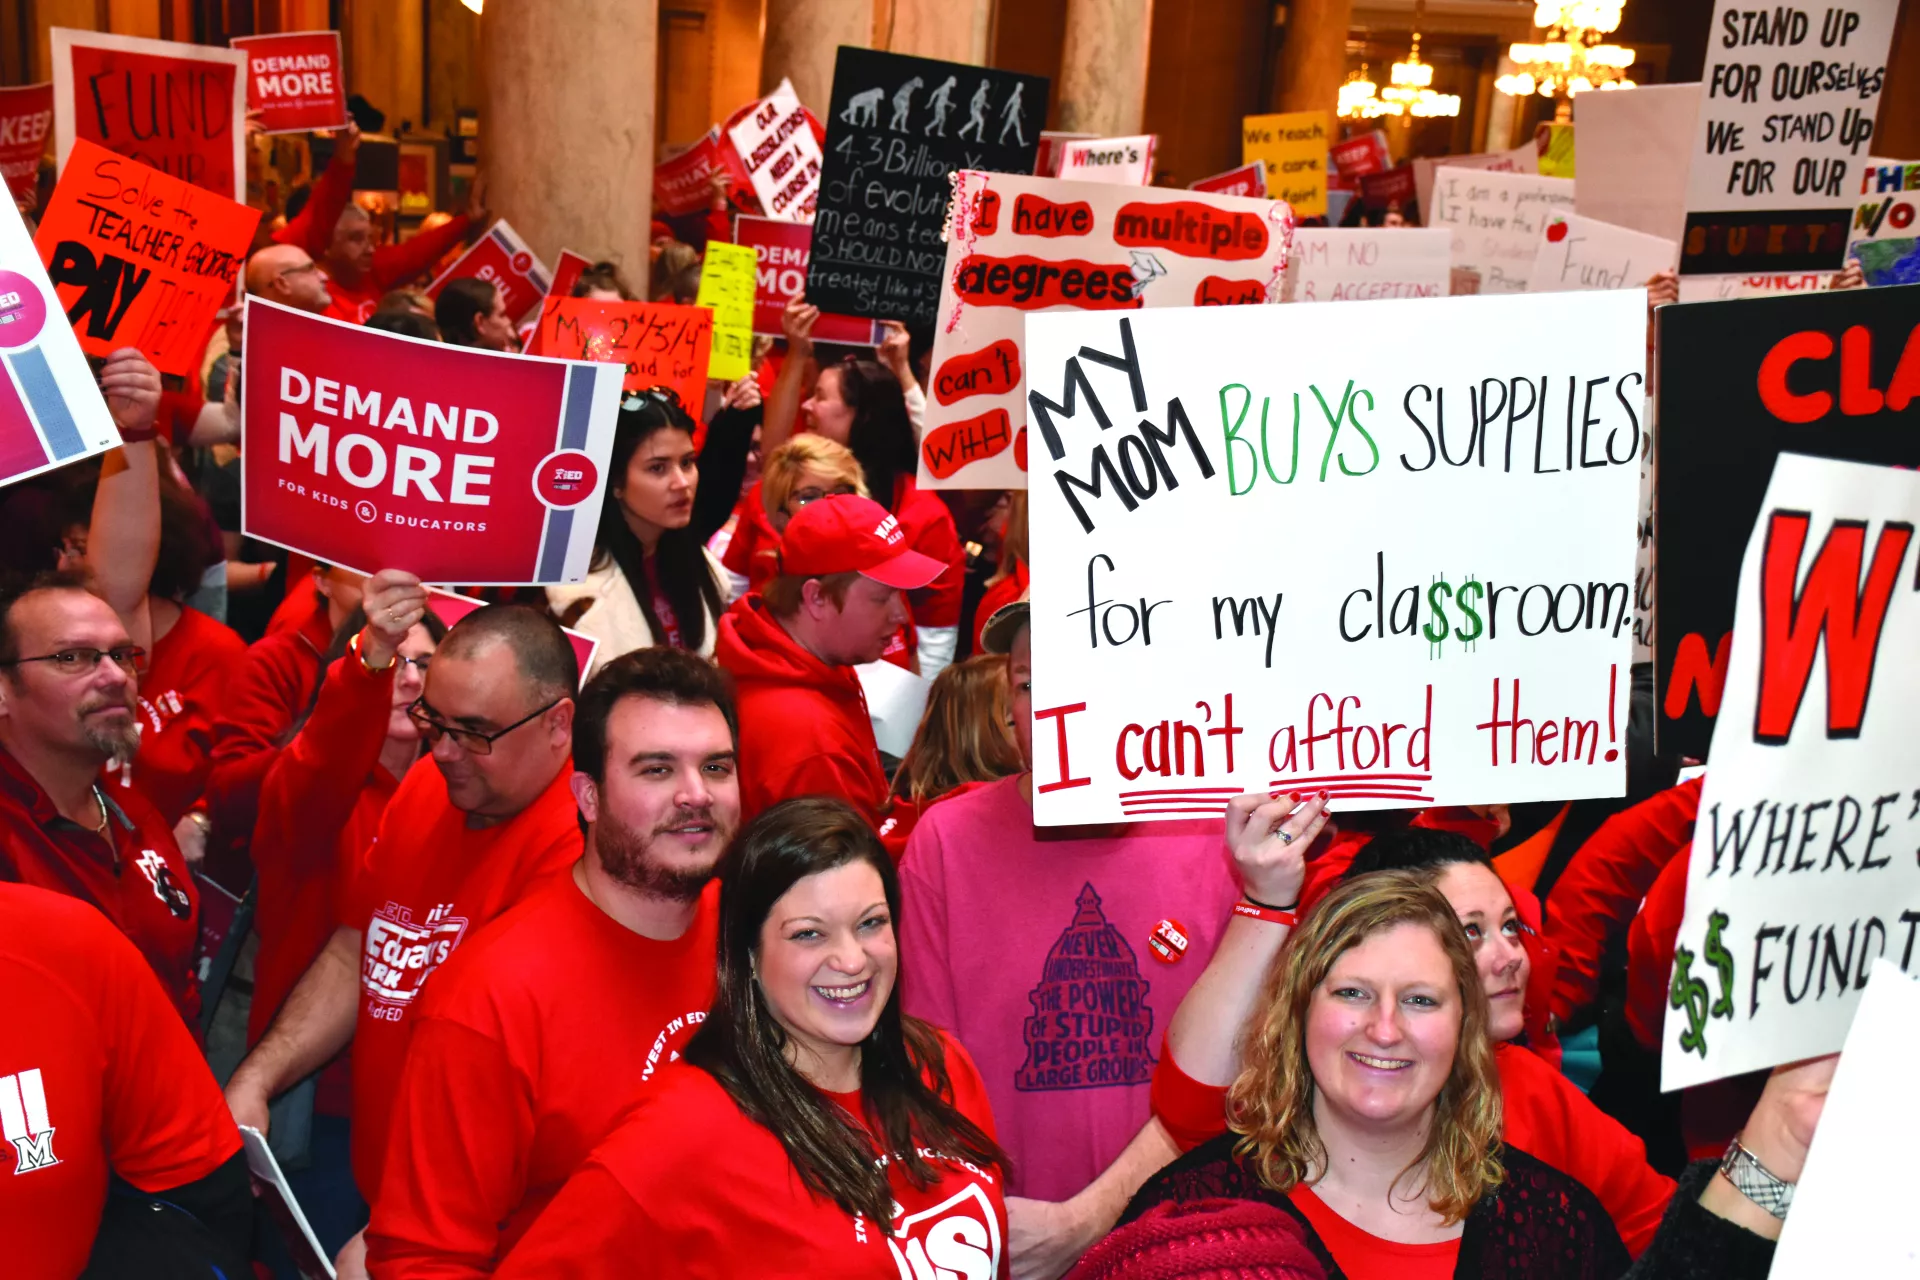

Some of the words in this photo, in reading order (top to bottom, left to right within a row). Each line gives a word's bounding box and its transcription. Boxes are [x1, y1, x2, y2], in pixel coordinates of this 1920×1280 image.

[1722, 7, 1808, 48] STAND
[1820, 8, 1860, 48] UP
[251, 54, 331, 74] DEMAND
[256, 72, 334, 98] MORE
[1709, 63, 1761, 103] FOR
[1771, 61, 1885, 101] OURSELVES
[89, 69, 230, 141] FUND
[756, 102, 778, 130] OUR
[743, 107, 806, 175] LEGISLATORS
[1706, 120, 1745, 155] WE
[1762, 112, 1835, 143] STAND
[1839, 108, 1874, 155] UP
[770, 151, 794, 182] NEED
[793, 144, 803, 158] A
[835, 134, 884, 168] 4.3
[884, 138, 957, 177] Billion
[1072, 146, 1138, 167] Where's
[86, 160, 164, 217] Solve
[772, 170, 808, 214] COURSE
[827, 167, 864, 204] of
[865, 181, 949, 216] evoluti
[1727, 158, 1775, 196] FOR
[1793, 158, 1847, 197] OUR
[77, 199, 184, 268] TEACHER
[815, 208, 900, 241] means
[974, 195, 996, 230] I
[1015, 197, 1089, 232] have
[1116, 209, 1263, 255] multiple
[1468, 206, 1506, 229] have
[817, 235, 901, 265] SHOULD
[904, 250, 946, 273] NOT
[1293, 241, 1329, 266] AM
[1347, 242, 1380, 266] NO
[1560, 237, 1631, 290] Fund
[50, 241, 151, 341] PAY
[807, 264, 881, 292] treated
[884, 275, 909, 296] like
[1332, 282, 1440, 302] ACCEPTING
[854, 290, 910, 313] Stone
[912, 301, 938, 324] Ag
[938, 348, 1011, 396] can't
[1028, 317, 1148, 461] MY
[280, 366, 499, 445] DEMAND
[278, 411, 496, 506] MORE
[1053, 397, 1216, 534] MOM
[1218, 379, 1380, 496] BUYS
[1399, 371, 1644, 475] SUPPLIES
[278, 478, 306, 497] FOR
[312, 490, 349, 511] KIDS
[384, 511, 488, 532] EDUCATORS
[1066, 554, 1173, 649] for
[1211, 592, 1283, 669] my
[1034, 701, 1092, 795] I
[1115, 692, 1244, 780] can't
[1268, 684, 1434, 775] afford
[1476, 663, 1620, 767] them!
[1706, 788, 1920, 879] WHERE'
[1059, 930, 1121, 958] NEVER
[1748, 914, 1887, 1021] FUND
[1040, 983, 1064, 1012] THE
[1069, 979, 1140, 1018] POWER
[666, 1016, 684, 1035] IN
[686, 1011, 710, 1025] ED
[1030, 1016, 1047, 1038] OF
[1055, 1011, 1145, 1038] STUPID
[1026, 1066, 1082, 1087] LARGE
[1086, 1056, 1149, 1084] GROUPS
[1034, 1038, 1121, 1069] PEOPLE
[1128, 1038, 1143, 1054] IN
